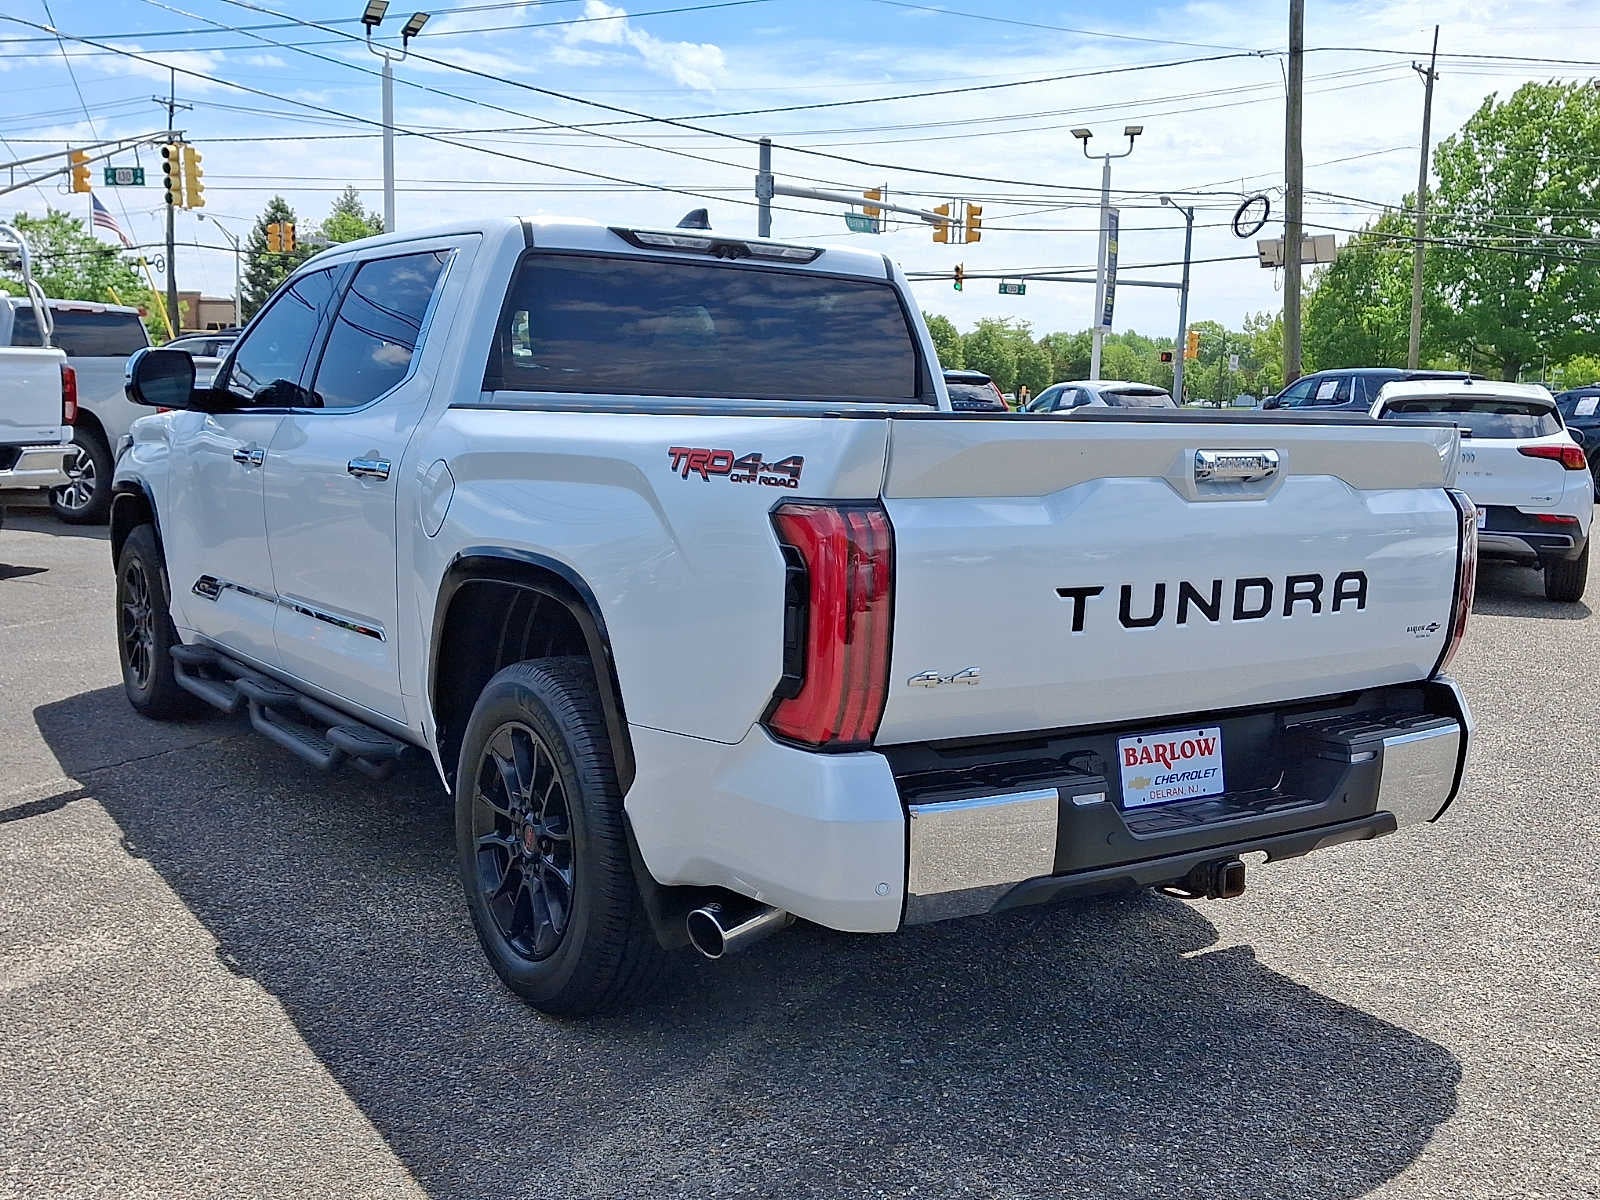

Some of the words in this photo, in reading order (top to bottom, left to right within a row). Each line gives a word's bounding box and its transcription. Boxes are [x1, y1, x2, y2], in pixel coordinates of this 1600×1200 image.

[668, 446, 734, 482] TRD
[730, 473, 757, 484] OFF
[758, 476, 798, 489] ROAD
[1055, 569, 1368, 633] TUNDRA
[1123, 737, 1216, 770] BARLOW
[1154, 768, 1218, 785] CHEVROLET
[1188, 784, 1199, 794] NJ
